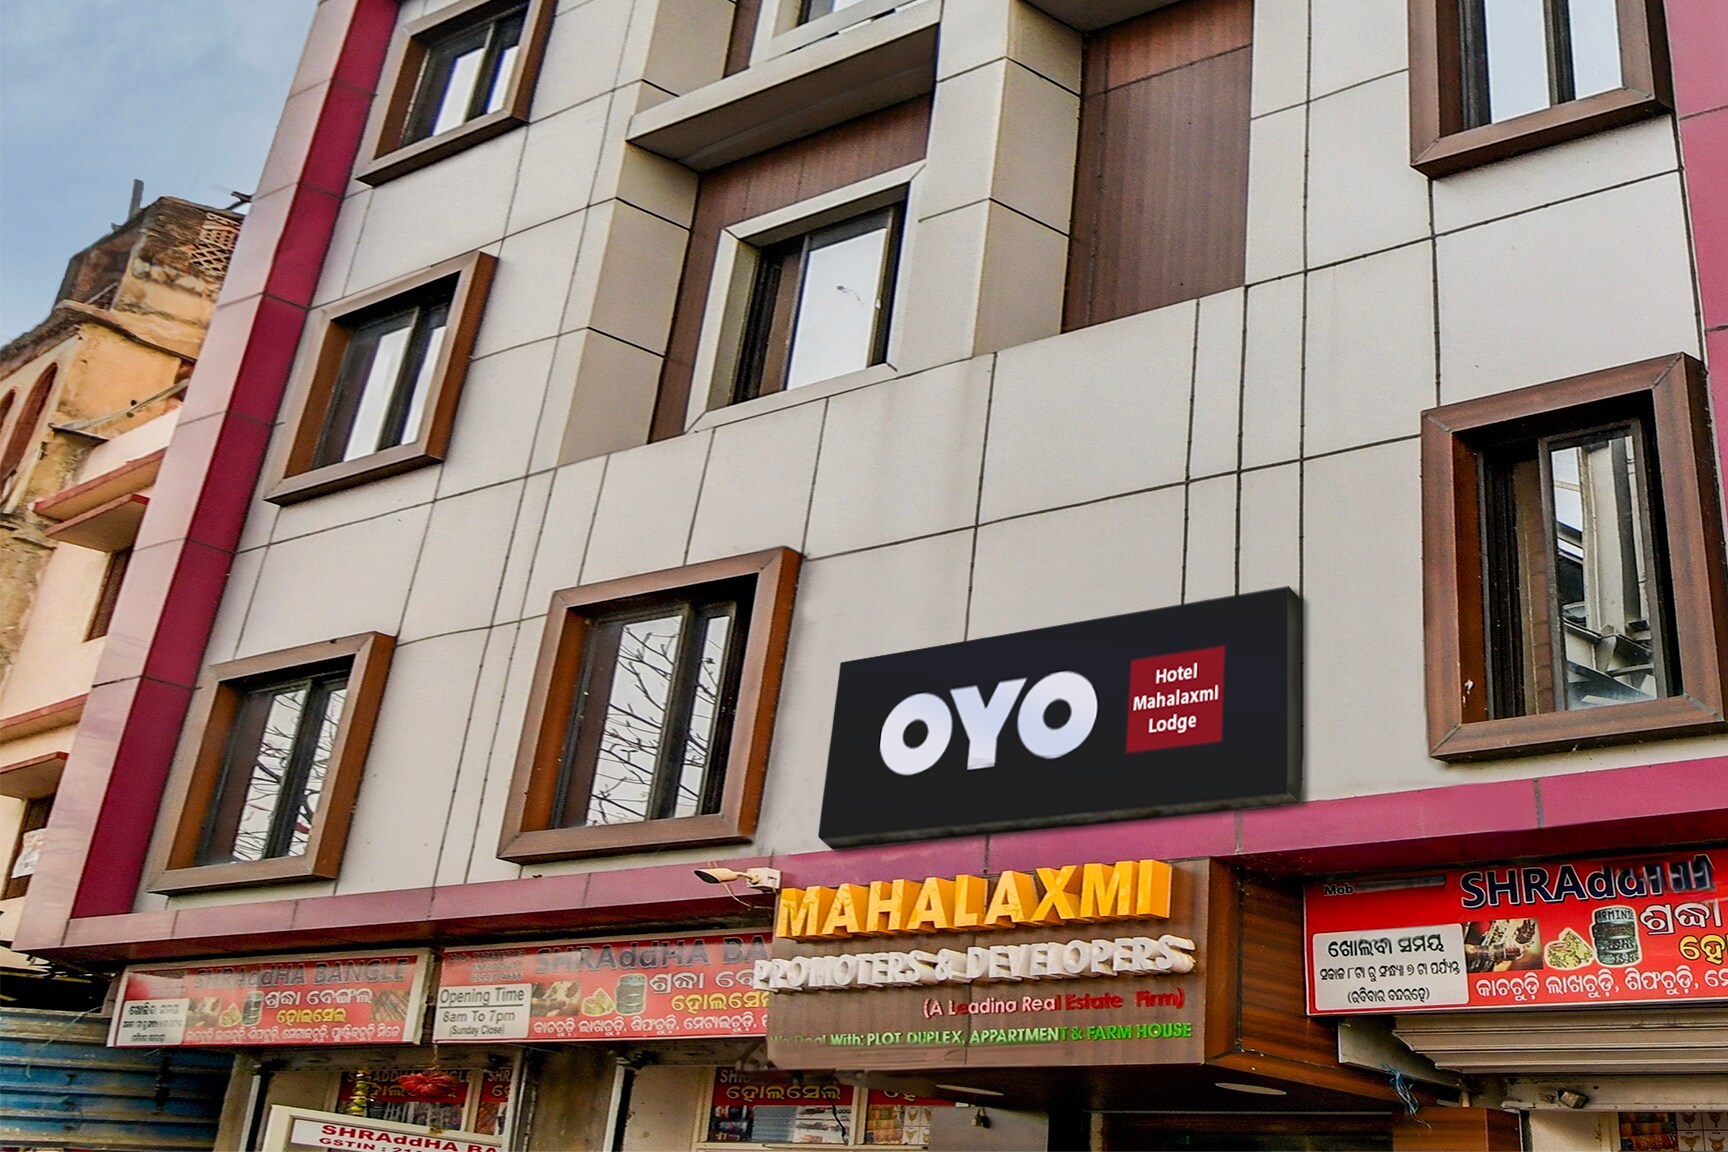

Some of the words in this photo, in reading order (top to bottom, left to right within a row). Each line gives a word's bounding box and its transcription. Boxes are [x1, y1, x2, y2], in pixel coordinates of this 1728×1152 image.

[1155, 662, 1198, 685] Hotel
[880, 670, 1098, 776] OYO
[1147, 712, 1197, 735] Lodge
[776, 859, 1172, 941] MAHALAXMI
[1324, 882, 1354, 896] Mob
[313, 957, 409, 985] BANGLE
[752, 948, 934, 993] PROMOTERS
[934, 946, 966, 981] &
[965, 933, 1197, 983] DEVELOPERS
[440, 988, 491, 1006] Opening
[494, 986, 525, 1002] Time
[1022, 995, 1062, 1013] Real
[1065, 992, 1124, 1011] Estate
[442, 1011, 468, 1023] 8am
[472, 1010, 486, 1023] To
[489, 1009, 516, 1024] 7pm
[867, 1031, 902, 1047] PLOT
[969, 1027, 1067, 1044] APPARTMENT
[1071, 1026, 1083, 1041] &
[1087, 1024, 1133, 1041] FARM
[1136, 1023, 1192, 1039] HOUSE
[318, 1137, 376, 1151] GSTIN
[321, 1124, 459, 1152] SHRAddHA
